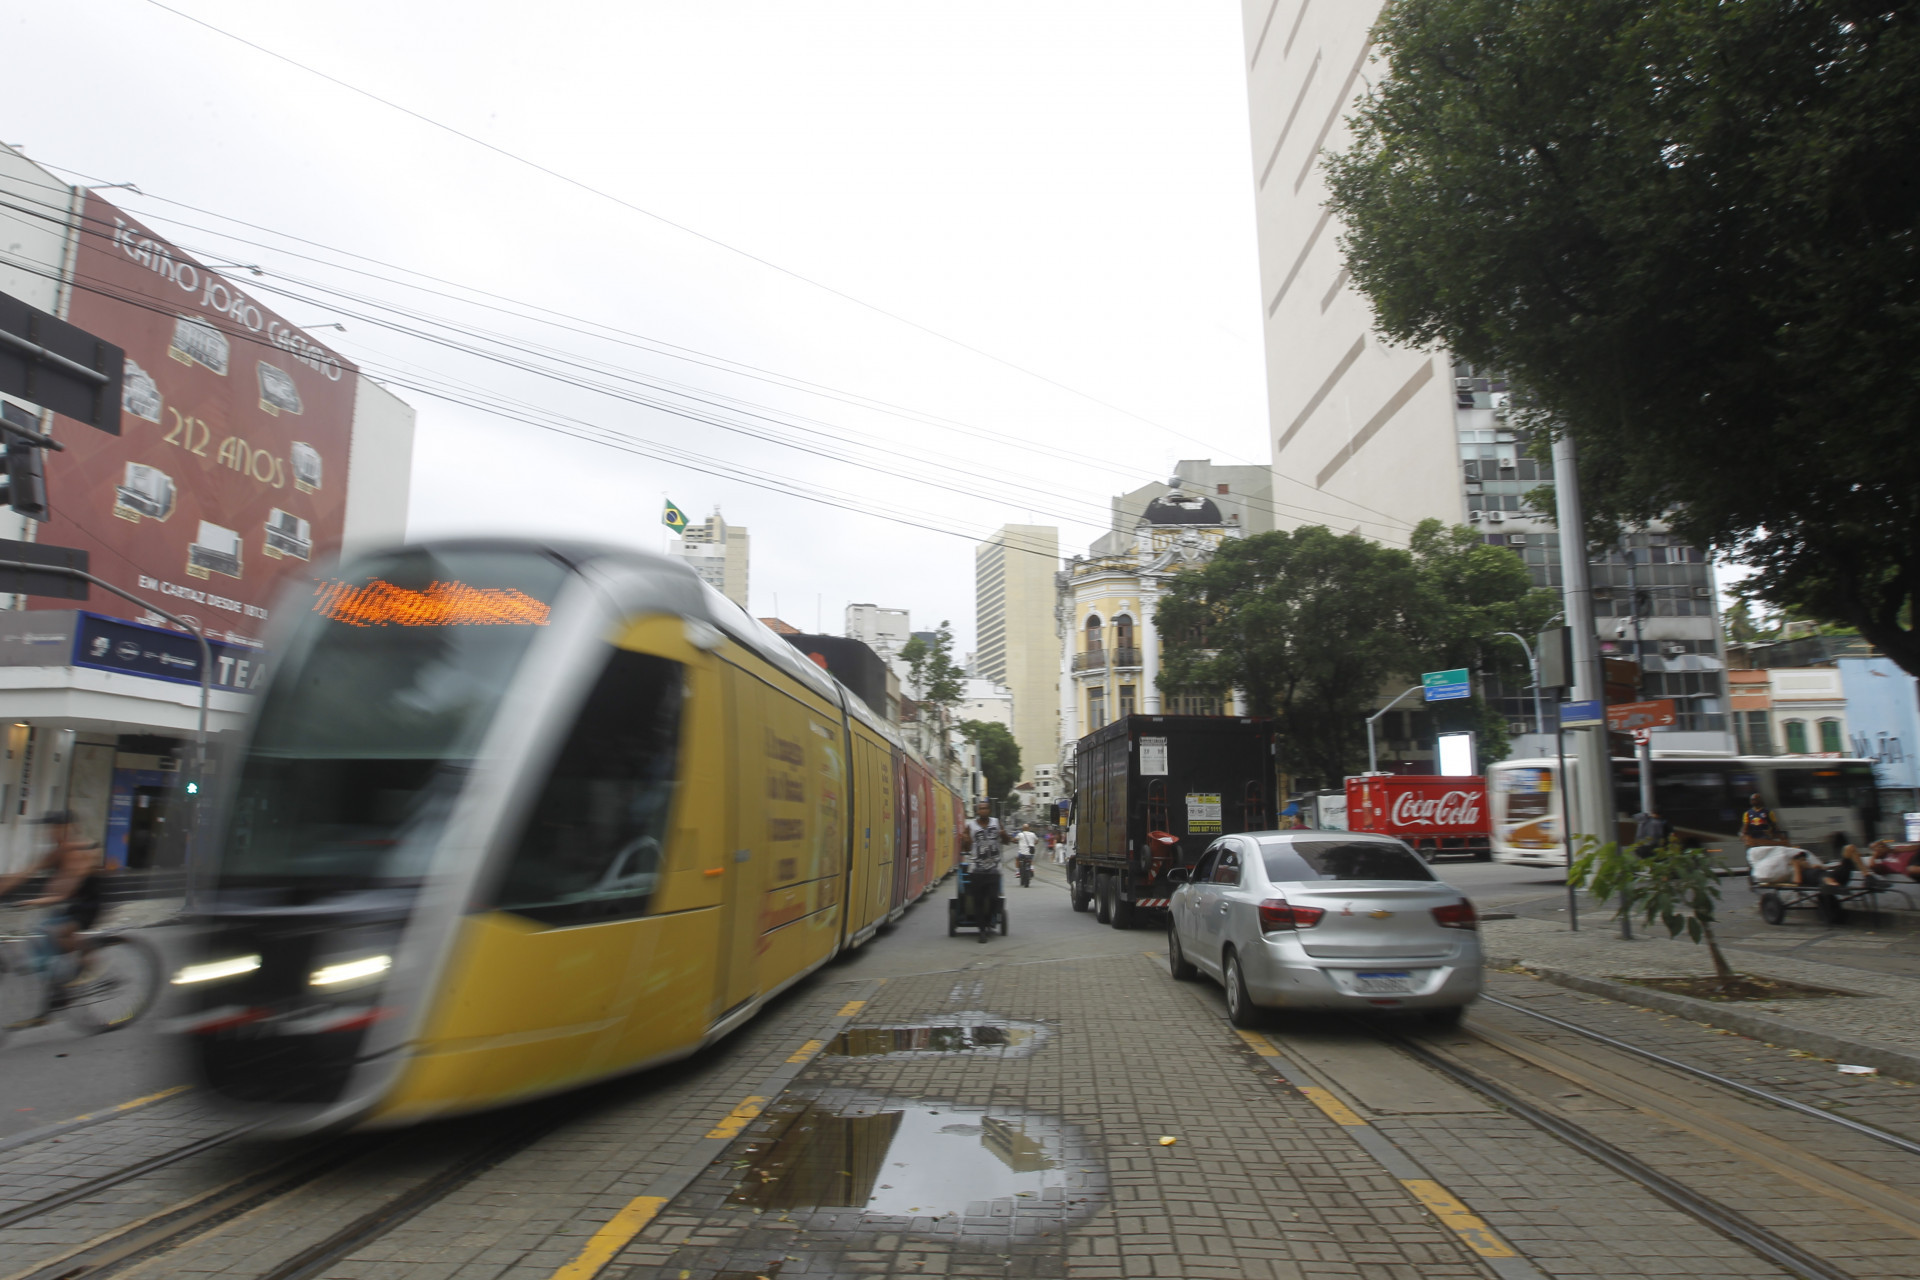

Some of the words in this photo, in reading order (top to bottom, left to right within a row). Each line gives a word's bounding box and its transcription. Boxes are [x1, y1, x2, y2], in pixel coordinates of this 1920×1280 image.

[113, 216, 199, 292] TEATRO
[200, 276, 263, 332] JOÃO
[163, 405, 210, 457] 212
[217, 435, 285, 489] ANOS
[138, 574, 159, 592] EM
[160, 581, 206, 604] CARTAZ
